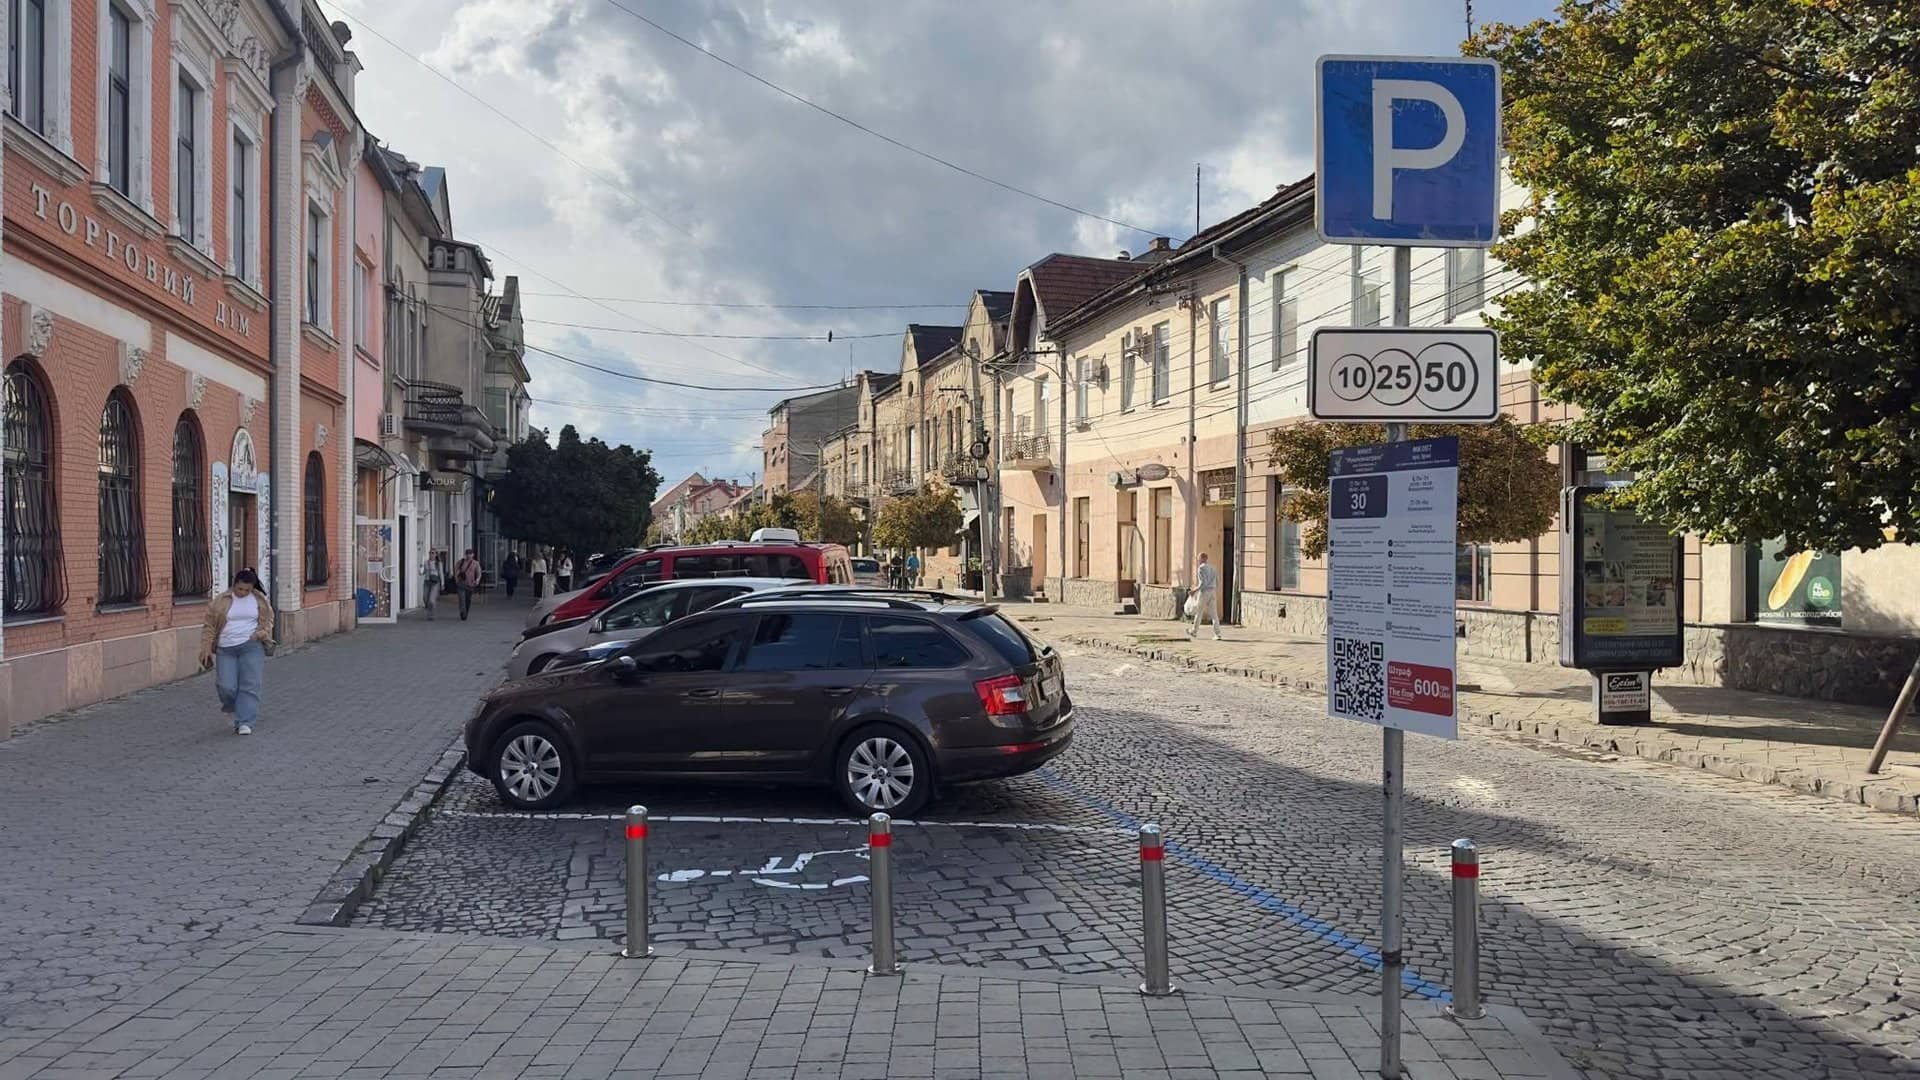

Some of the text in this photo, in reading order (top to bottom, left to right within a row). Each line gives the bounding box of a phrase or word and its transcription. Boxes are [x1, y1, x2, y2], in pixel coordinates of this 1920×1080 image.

[1372, 79, 1466, 220] P
[31, 181, 250, 338] ТОРГОВИЙ ДІМ
[1338, 362, 1466, 393] 10 25 50
[1350, 492, 1367, 510] 30
[1388, 665, 1412, 678] Штраф
[1389, 687, 1415, 699] The fine
[1414, 678, 1440, 697] 600
